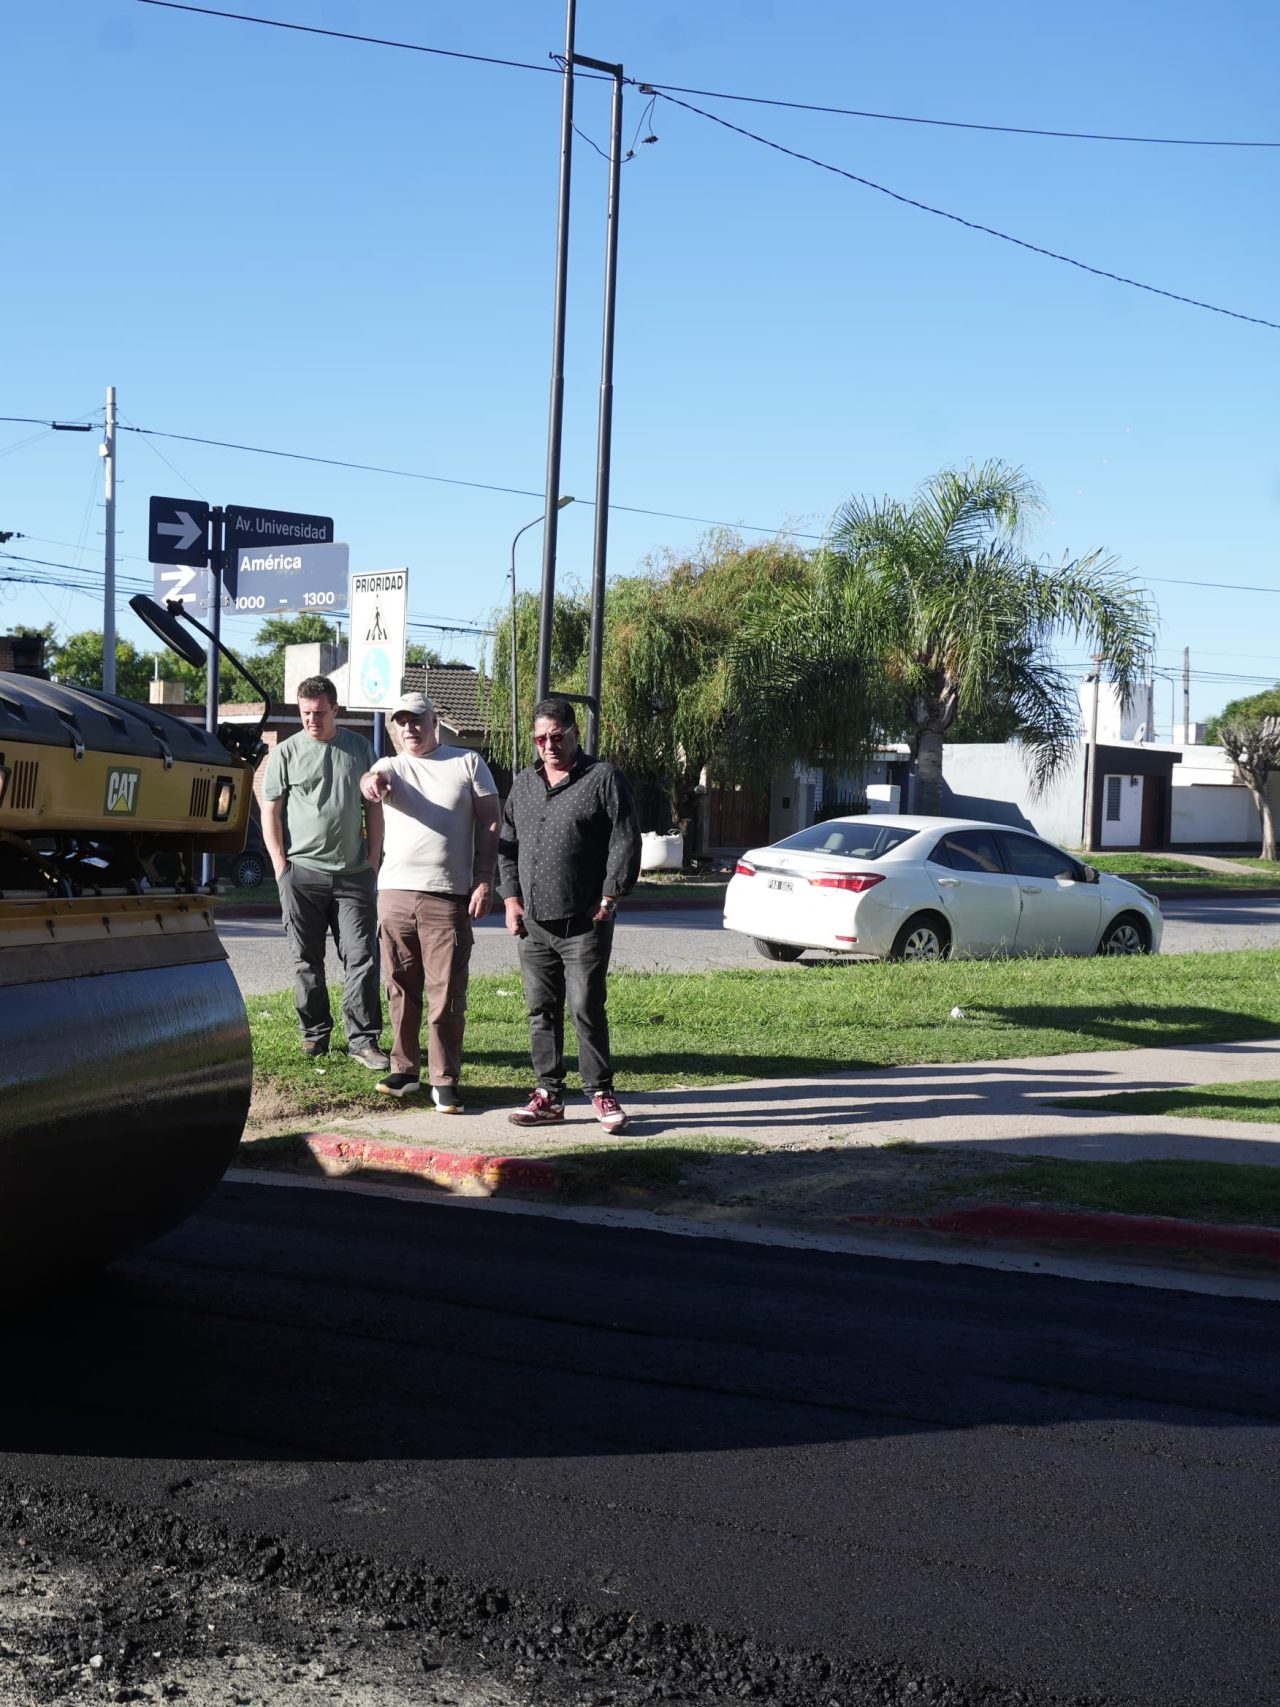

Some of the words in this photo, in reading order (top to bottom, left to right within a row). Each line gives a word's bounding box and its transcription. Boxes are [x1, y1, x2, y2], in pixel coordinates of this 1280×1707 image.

[235, 515, 254, 532] Av.
[256, 518, 326, 540] Universidad
[240, 554, 302, 572] América
[355, 575, 404, 593] PRIORIDAD
[235, 595, 265, 610] 1000
[303, 591, 335, 606] 1300
[107, 771, 138, 812] CAT
